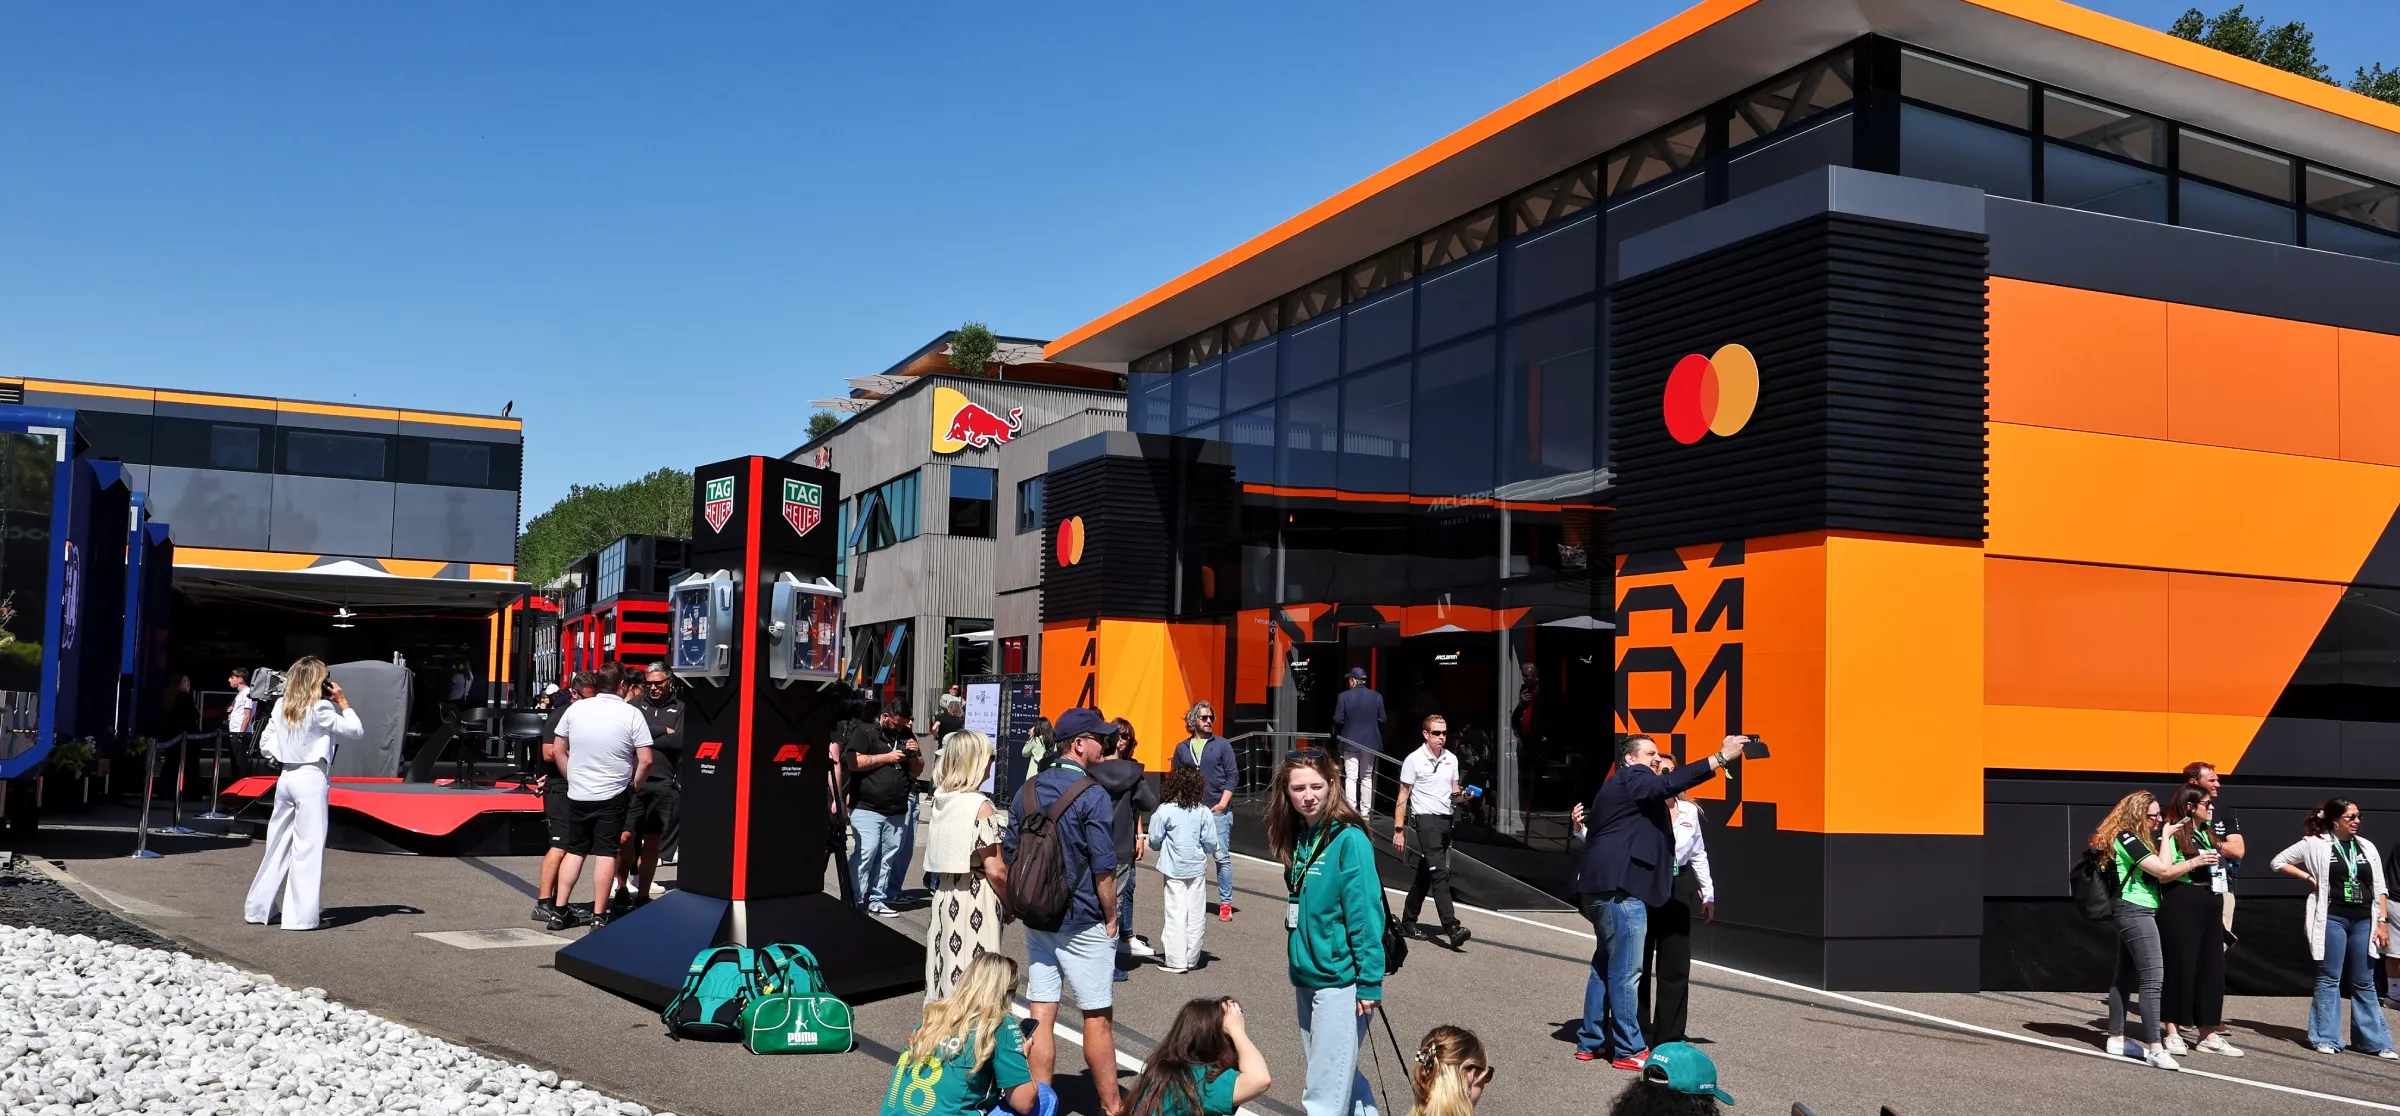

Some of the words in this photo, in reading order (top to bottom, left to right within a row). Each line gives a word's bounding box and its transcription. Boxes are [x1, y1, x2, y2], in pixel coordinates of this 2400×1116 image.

[708, 481, 731, 500] TAG
[787, 483, 819, 505] TAG
[706, 501, 731, 529] HEUER
[785, 504, 819, 532] HEUER
[787, 1032, 818, 1043] PUMA
[1652, 1053, 1670, 1064] BOSS
[888, 1051, 943, 1116] 18
